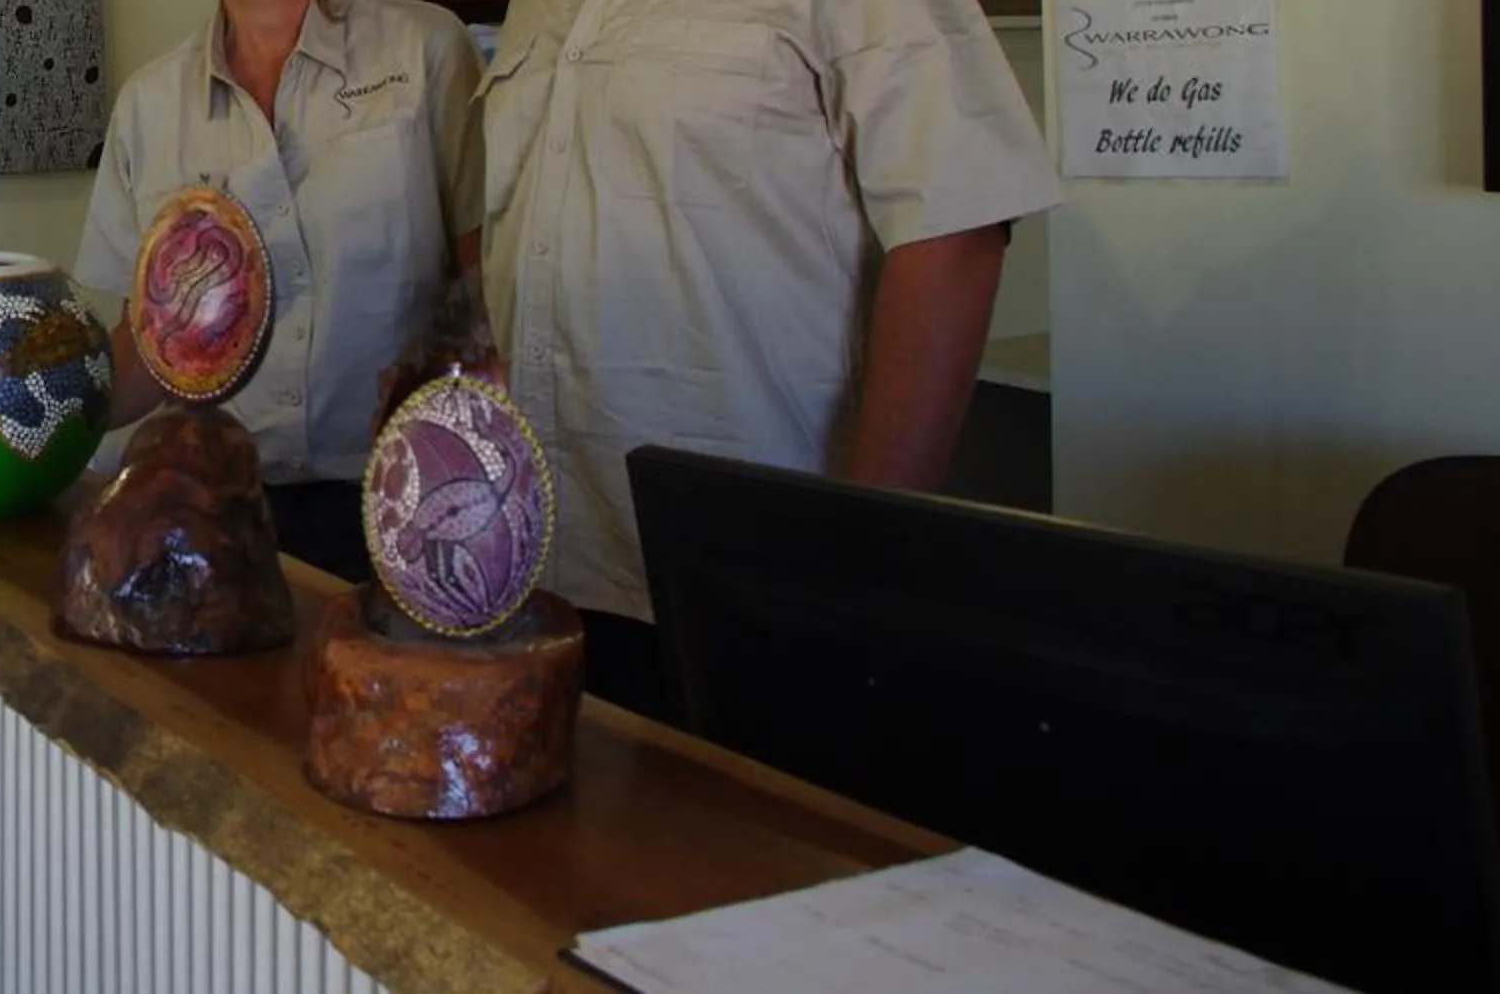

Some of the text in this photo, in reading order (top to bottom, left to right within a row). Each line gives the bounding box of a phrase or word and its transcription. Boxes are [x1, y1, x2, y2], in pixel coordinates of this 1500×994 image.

[1084, 23, 1270, 45] WARRAWONG
[1108, 76, 1223, 109] We do Gas
[1094, 125, 1243, 158] Bottle refills
